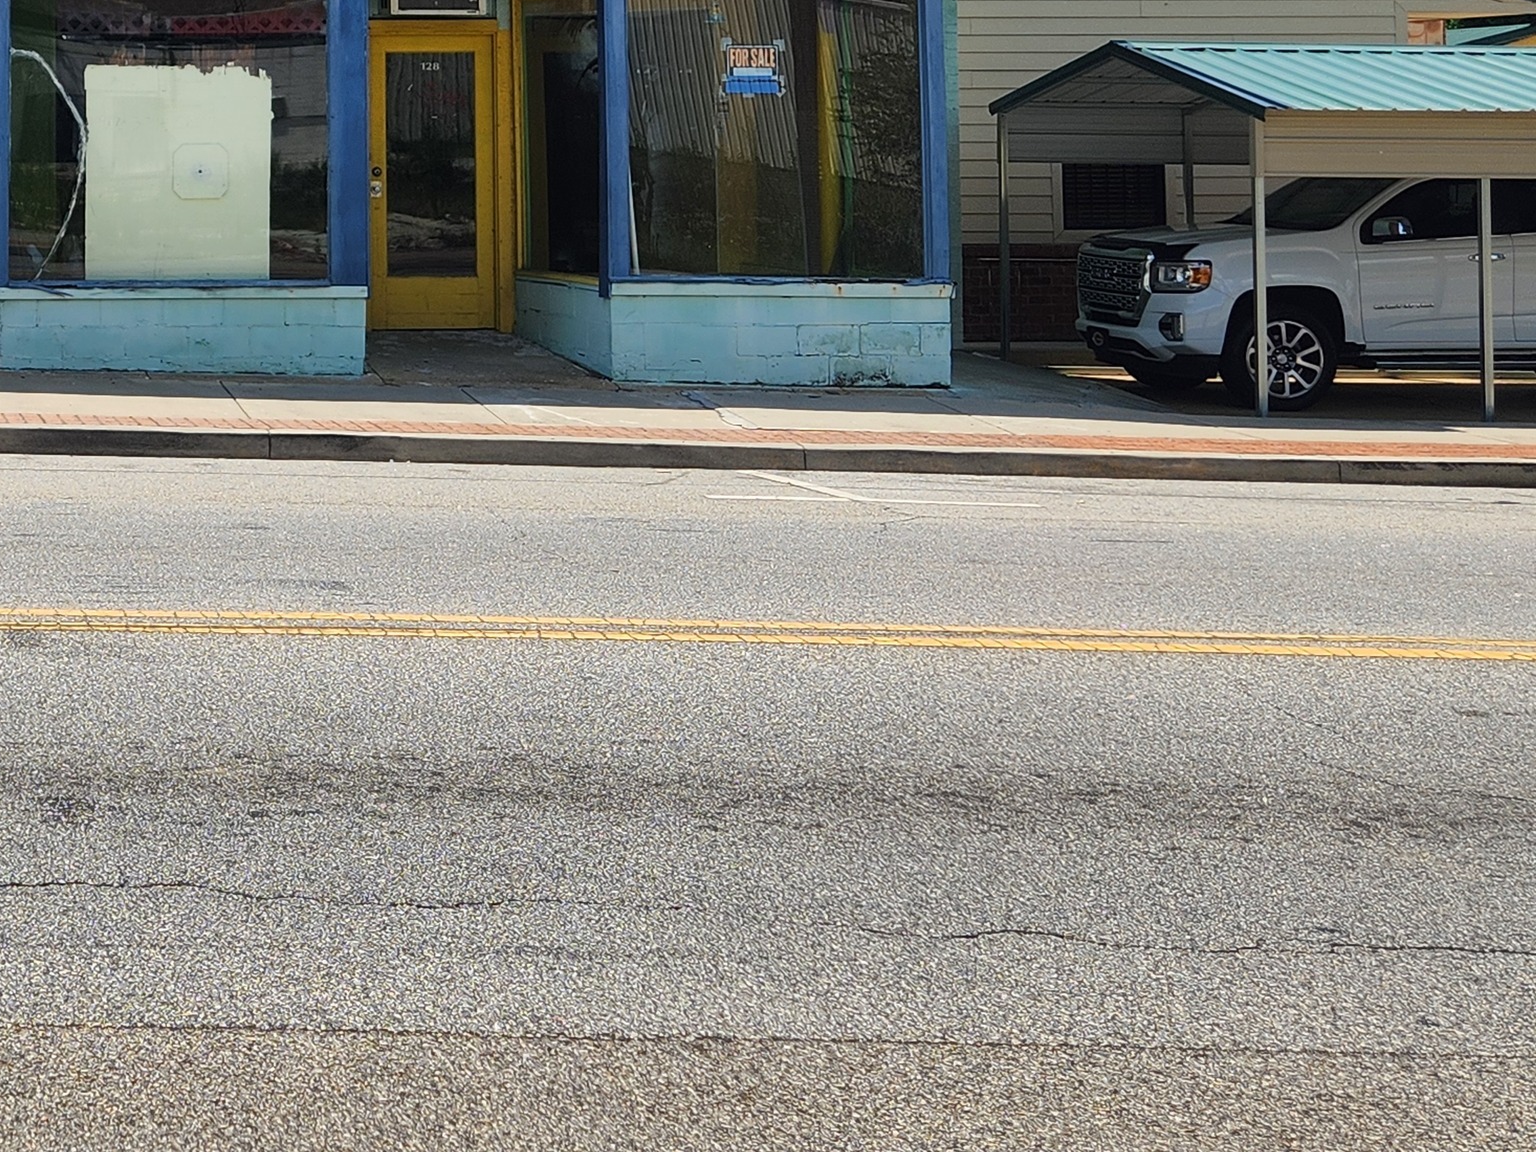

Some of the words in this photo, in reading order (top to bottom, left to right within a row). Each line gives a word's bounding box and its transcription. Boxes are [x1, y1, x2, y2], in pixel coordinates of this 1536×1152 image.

[729, 48, 749, 67] FOR
[750, 48, 776, 68] SALE
[420, 61, 440, 71] 128
